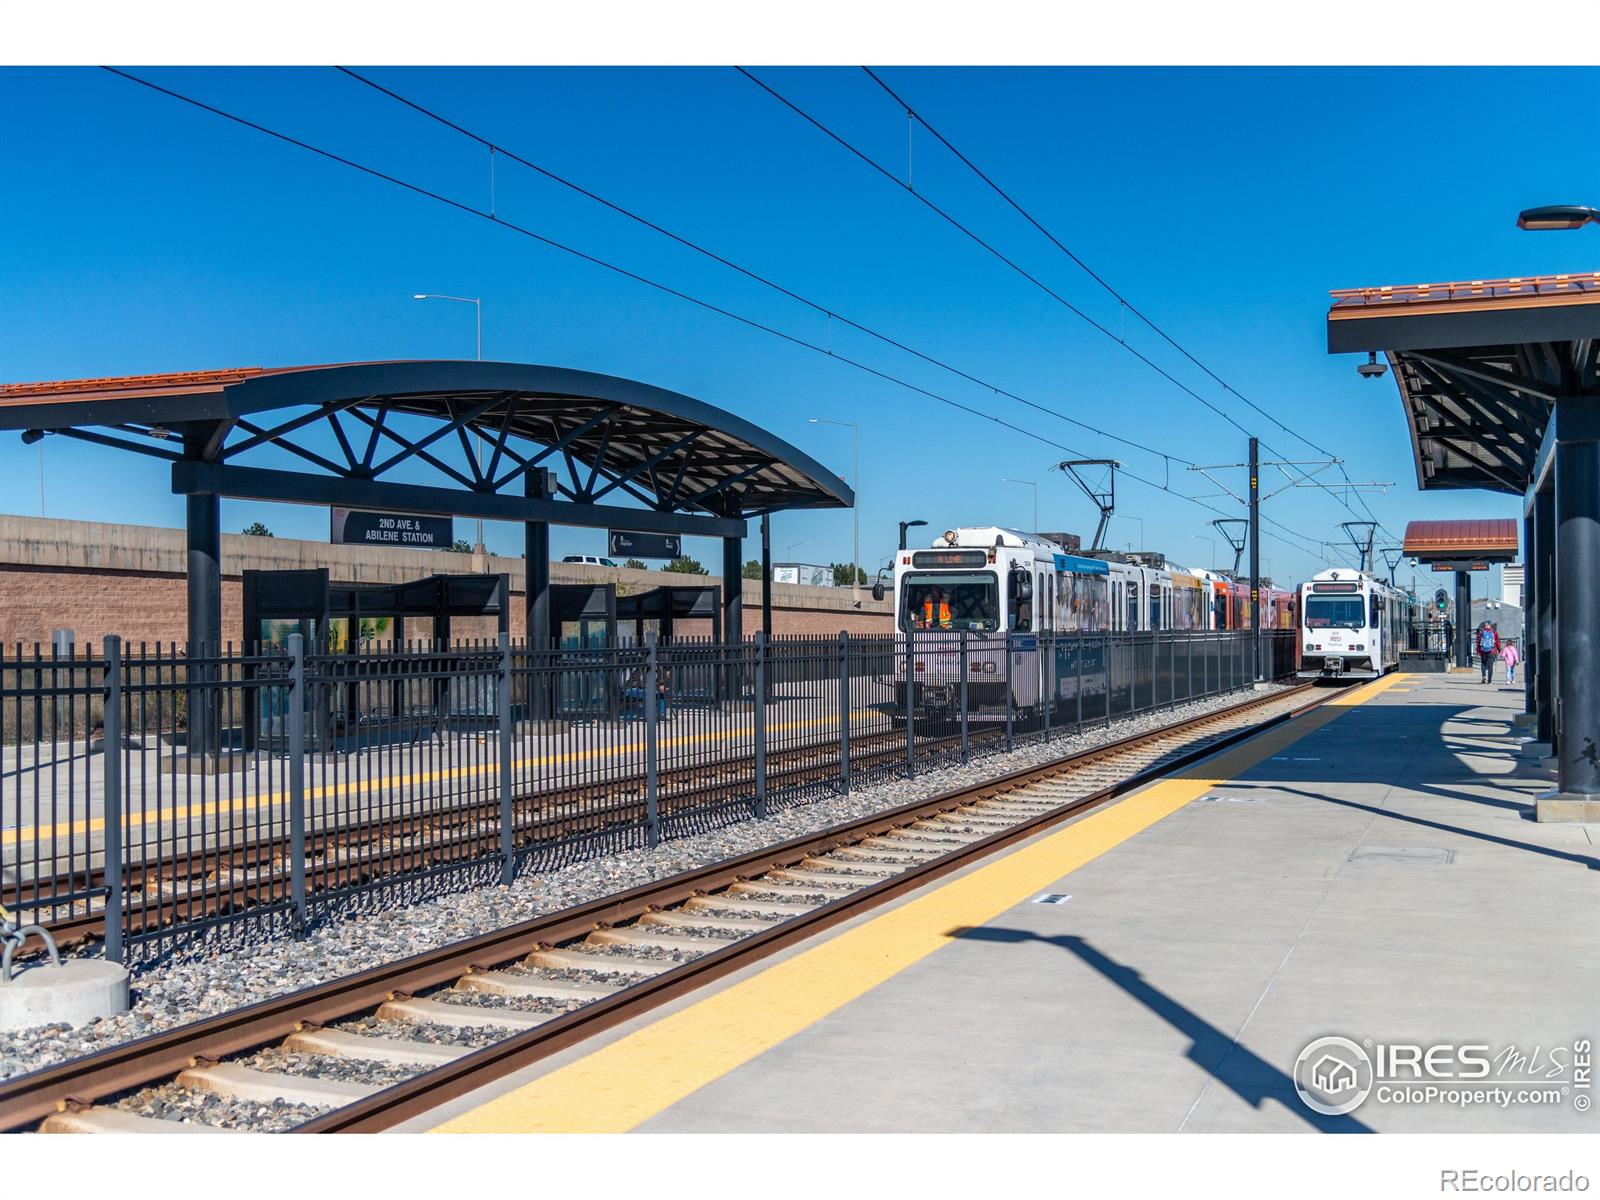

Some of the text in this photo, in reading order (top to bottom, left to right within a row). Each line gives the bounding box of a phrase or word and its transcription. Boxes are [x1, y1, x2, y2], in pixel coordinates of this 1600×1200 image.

[379, 518, 421, 530] 2ND AVE. &
[365, 530, 434, 543] ABILENE STATION
